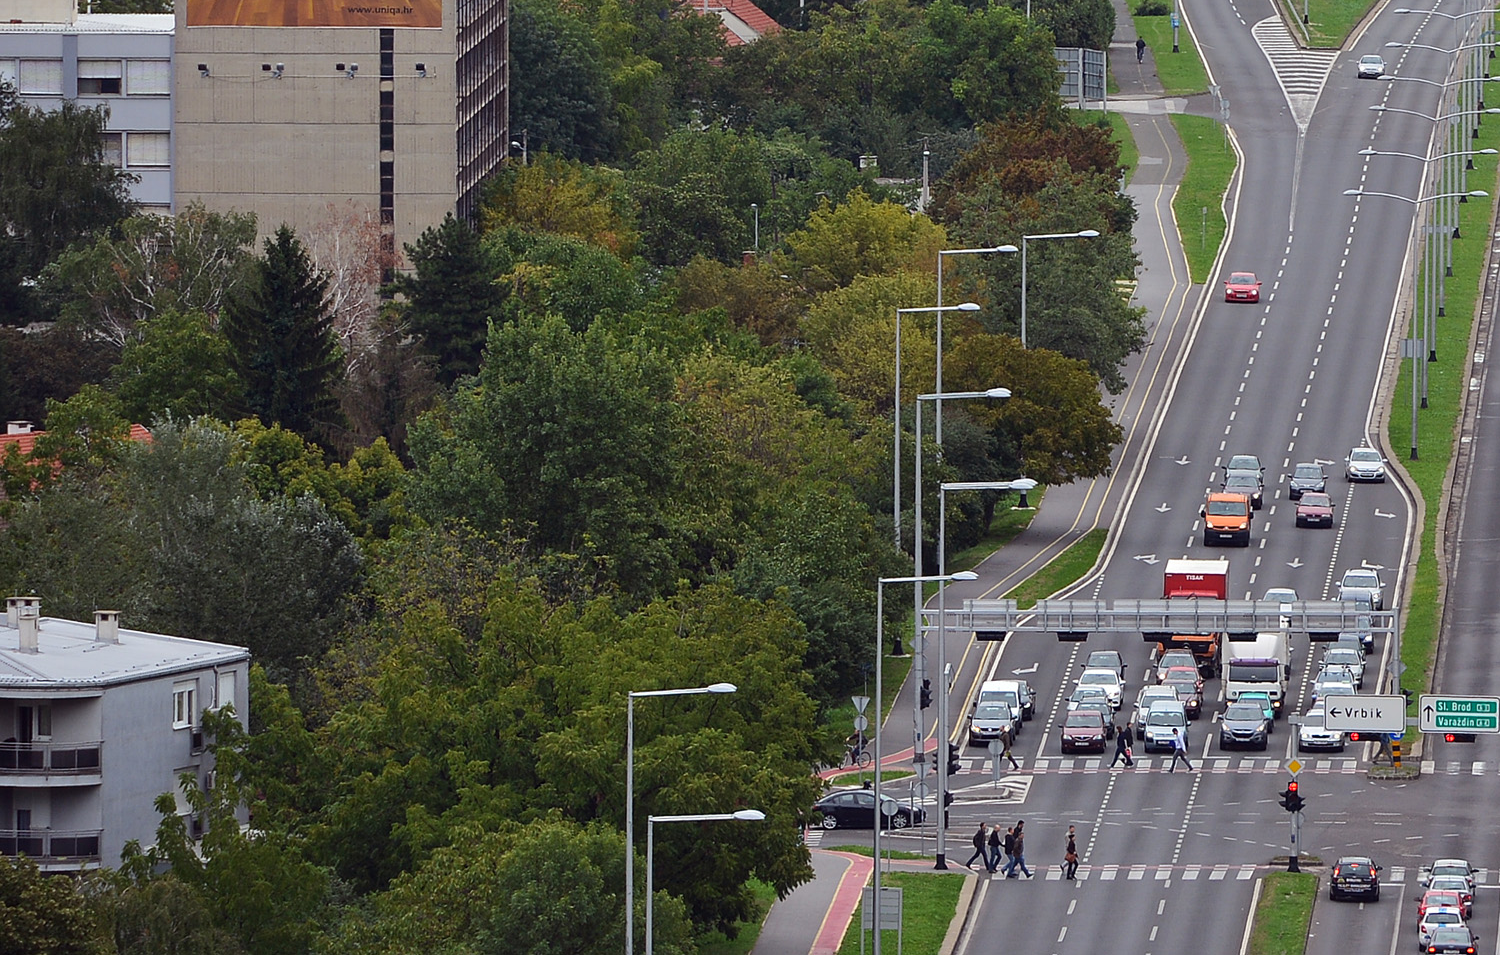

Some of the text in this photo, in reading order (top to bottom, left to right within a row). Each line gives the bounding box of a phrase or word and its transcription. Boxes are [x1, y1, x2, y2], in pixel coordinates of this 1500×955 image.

[348, 5, 414, 16] www.uniqa.hr
[1438, 701, 1449, 711] Sl.
[1451, 701, 1472, 712] Brod
[1345, 707, 1382, 719] Vrbik
[1438, 715, 1475, 727] Varaždin
